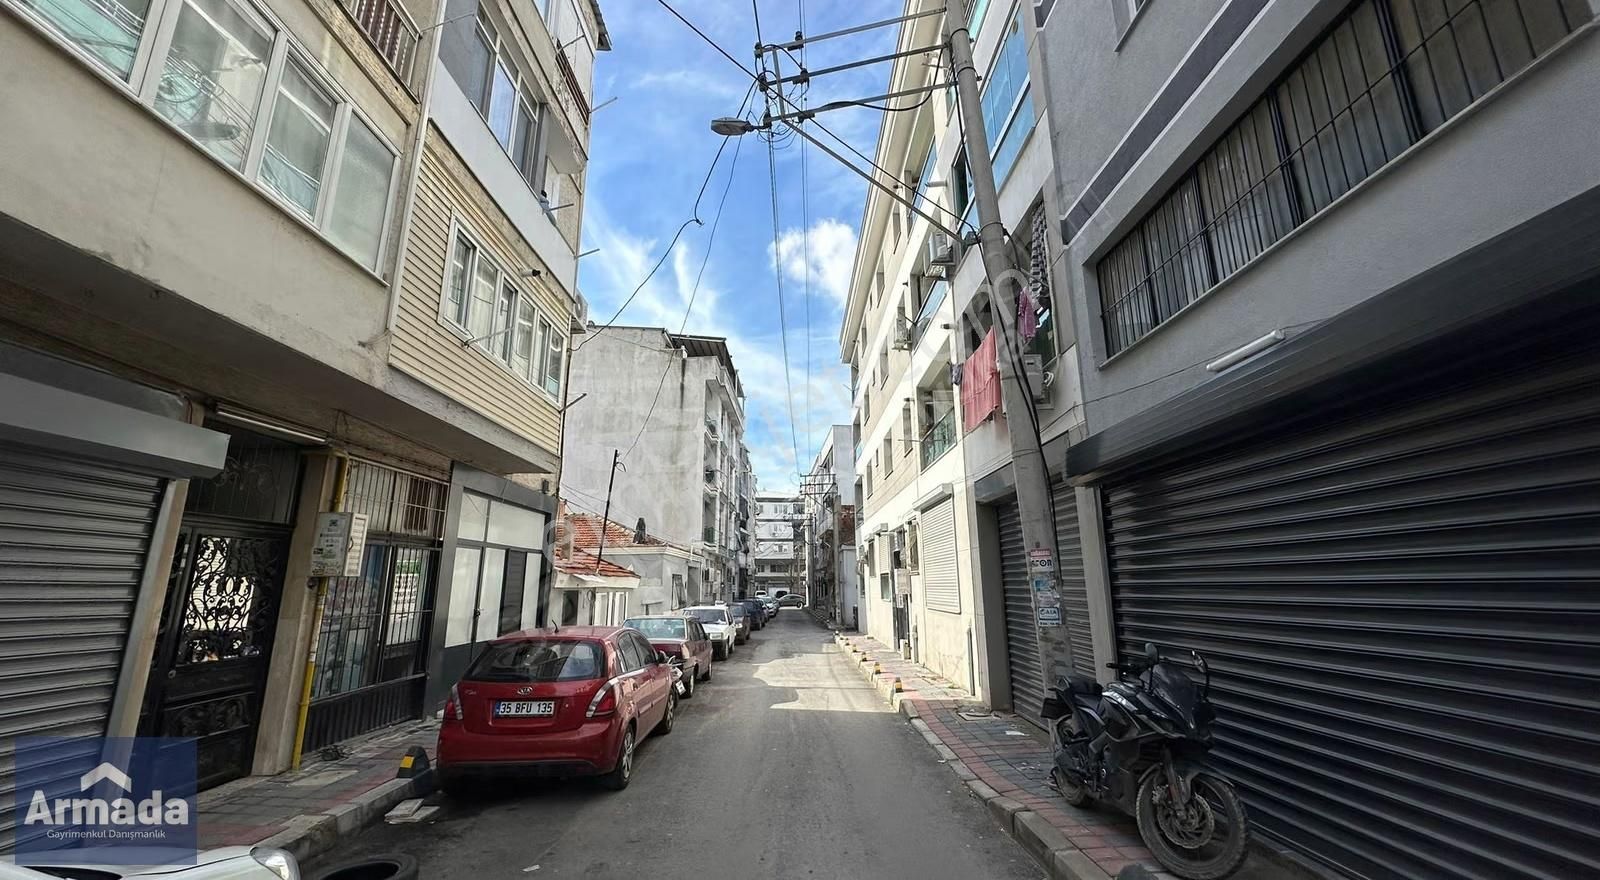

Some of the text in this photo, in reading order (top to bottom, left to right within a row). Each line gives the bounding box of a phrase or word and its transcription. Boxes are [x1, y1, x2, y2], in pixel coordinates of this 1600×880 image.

[500, 702, 553, 714] 35 BFU 135
